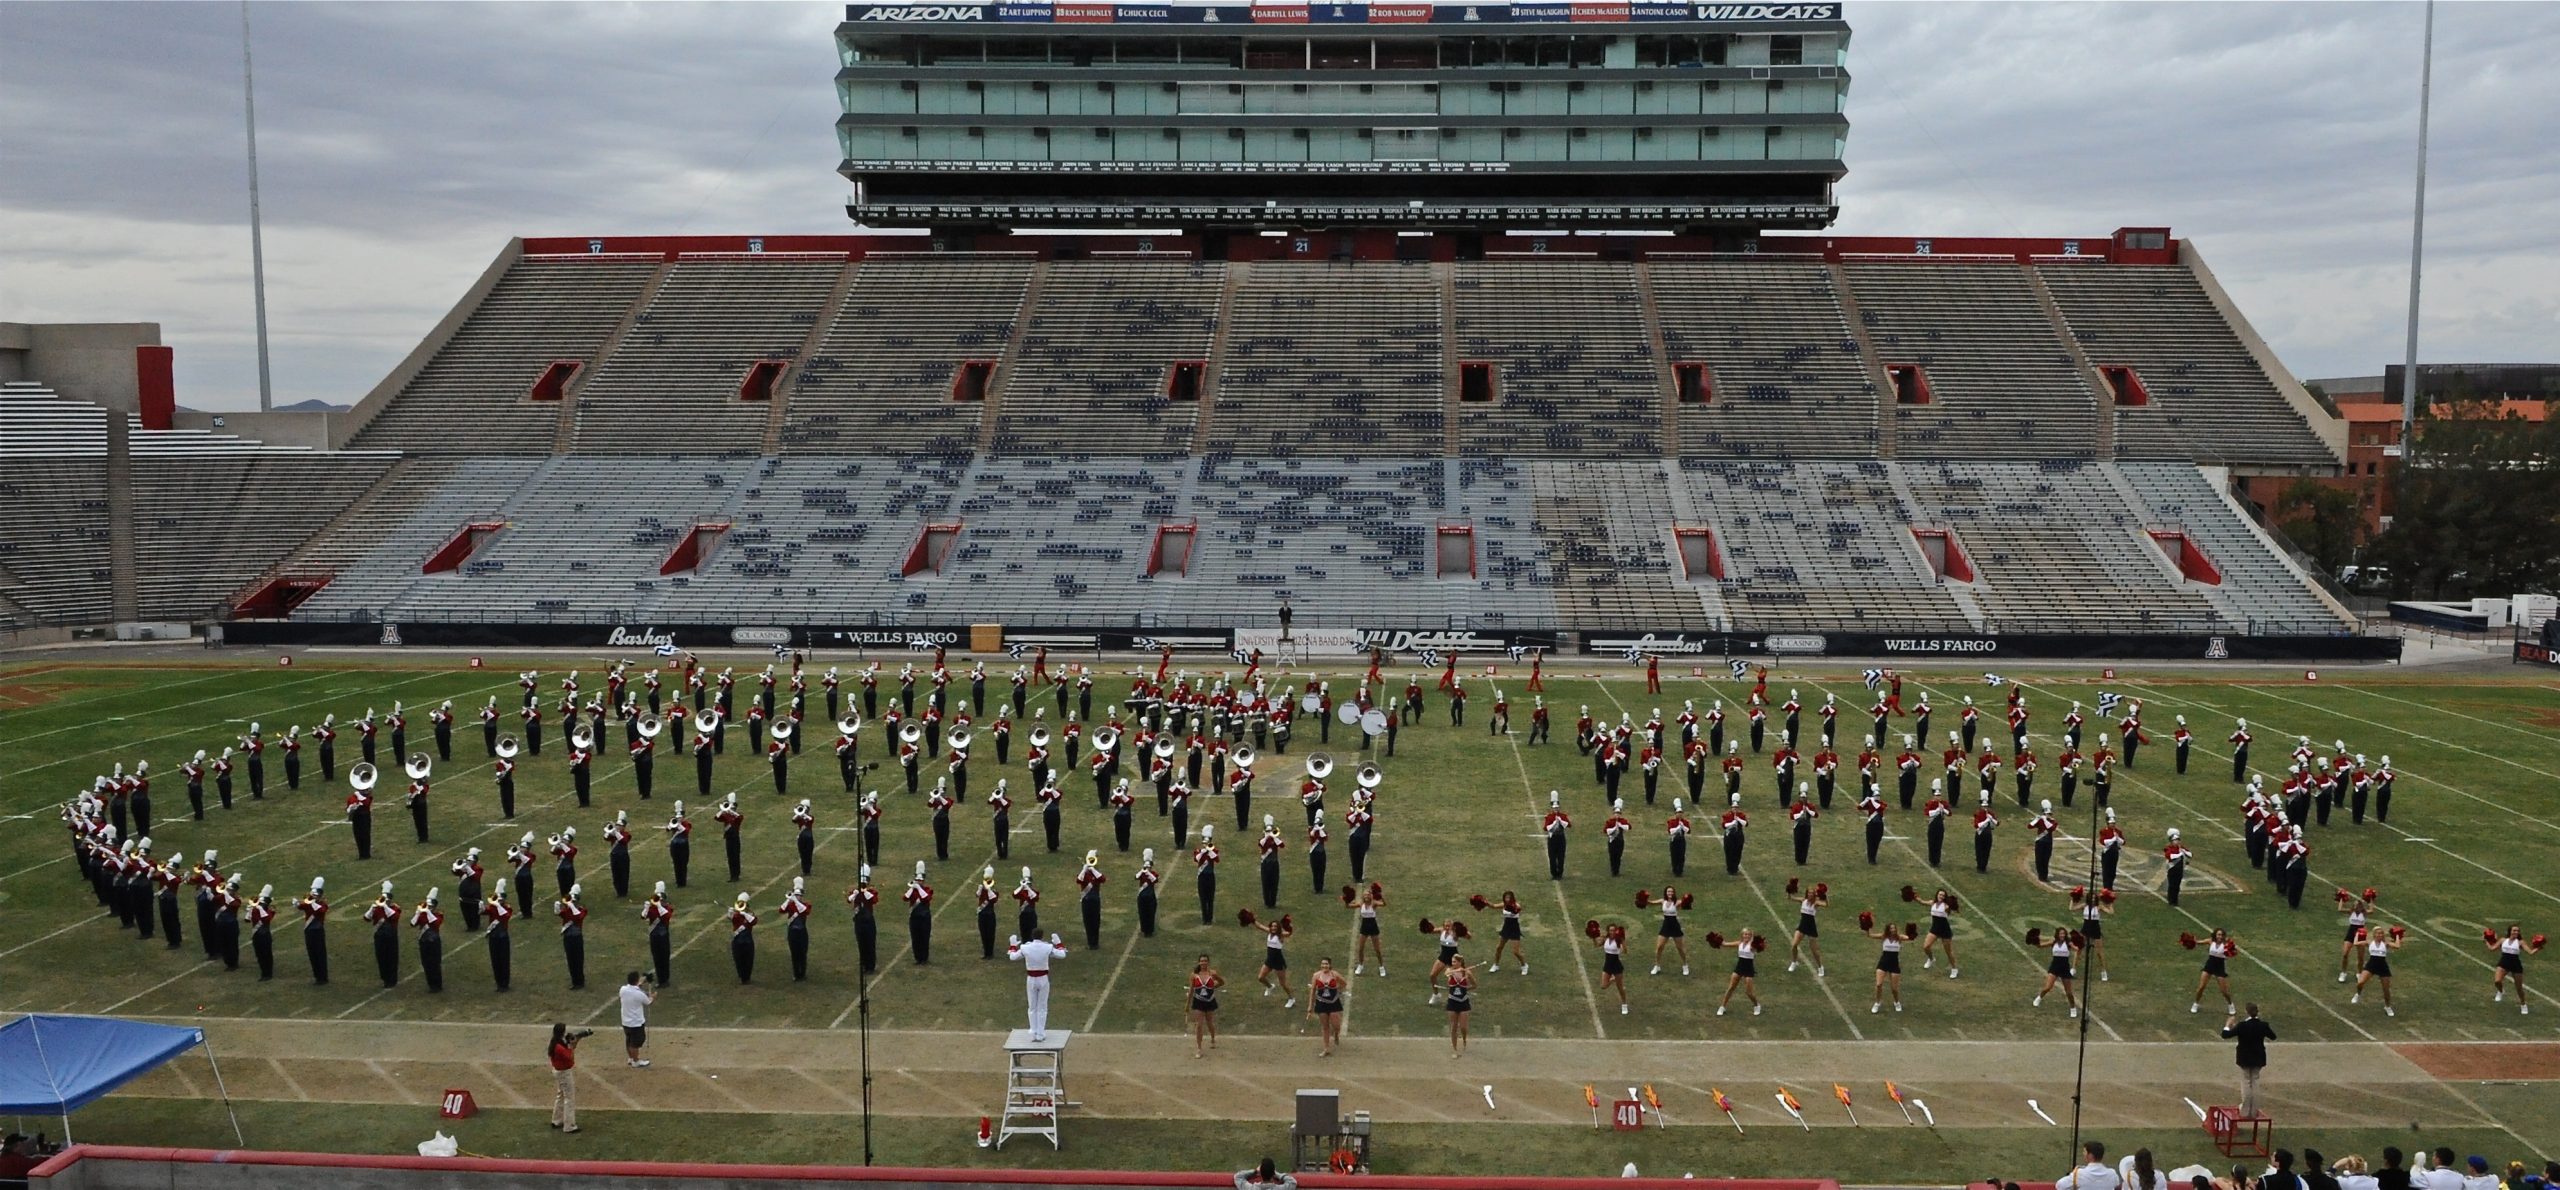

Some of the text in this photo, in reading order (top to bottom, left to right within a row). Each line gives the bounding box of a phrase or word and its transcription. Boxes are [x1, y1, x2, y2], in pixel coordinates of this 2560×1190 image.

[860, 7, 983, 21] ARIZONA
[999, 7, 1051, 16] 22 ART LUPPINO
[1065, 8, 1085, 17] RICKY
[1086, 9, 1112, 17] HUNLEY
[1123, 9, 1147, 17] CHUCK
[1148, 9, 1168, 17] CECIL
[1251, 9, 1308, 18] 4 DARRYLL LEWIS
[1368, 9, 1426, 17] 92 ROB WALDROP
[1520, 8, 1535, 16] STEVE
[1577, 8, 1596, 16] CHRIS
[1597, 8, 1629, 16] McALISTER
[1636, 8, 1664, 16] ANTOINE
[1665, 8, 1688, 16] CASON
[1697, 5, 1833, 20] WILDCATS
[591, 244, 602, 254] 17
[750, 243, 762, 253] 18
[1296, 242, 1308, 252] 21
[1916, 245, 1930, 255] 24
[2064, 246, 2078, 255] 25
[214, 417, 224, 426] 16
[607, 626, 676, 646] Bashas'
[847, 632, 958, 643] WELLS FARGO
[1318, 635, 1338, 646] BAND
[1884, 639, 1997, 651] WELLS FARGO
[444, 1094, 463, 1114] 40
[1618, 1105, 1637, 1125] 40
